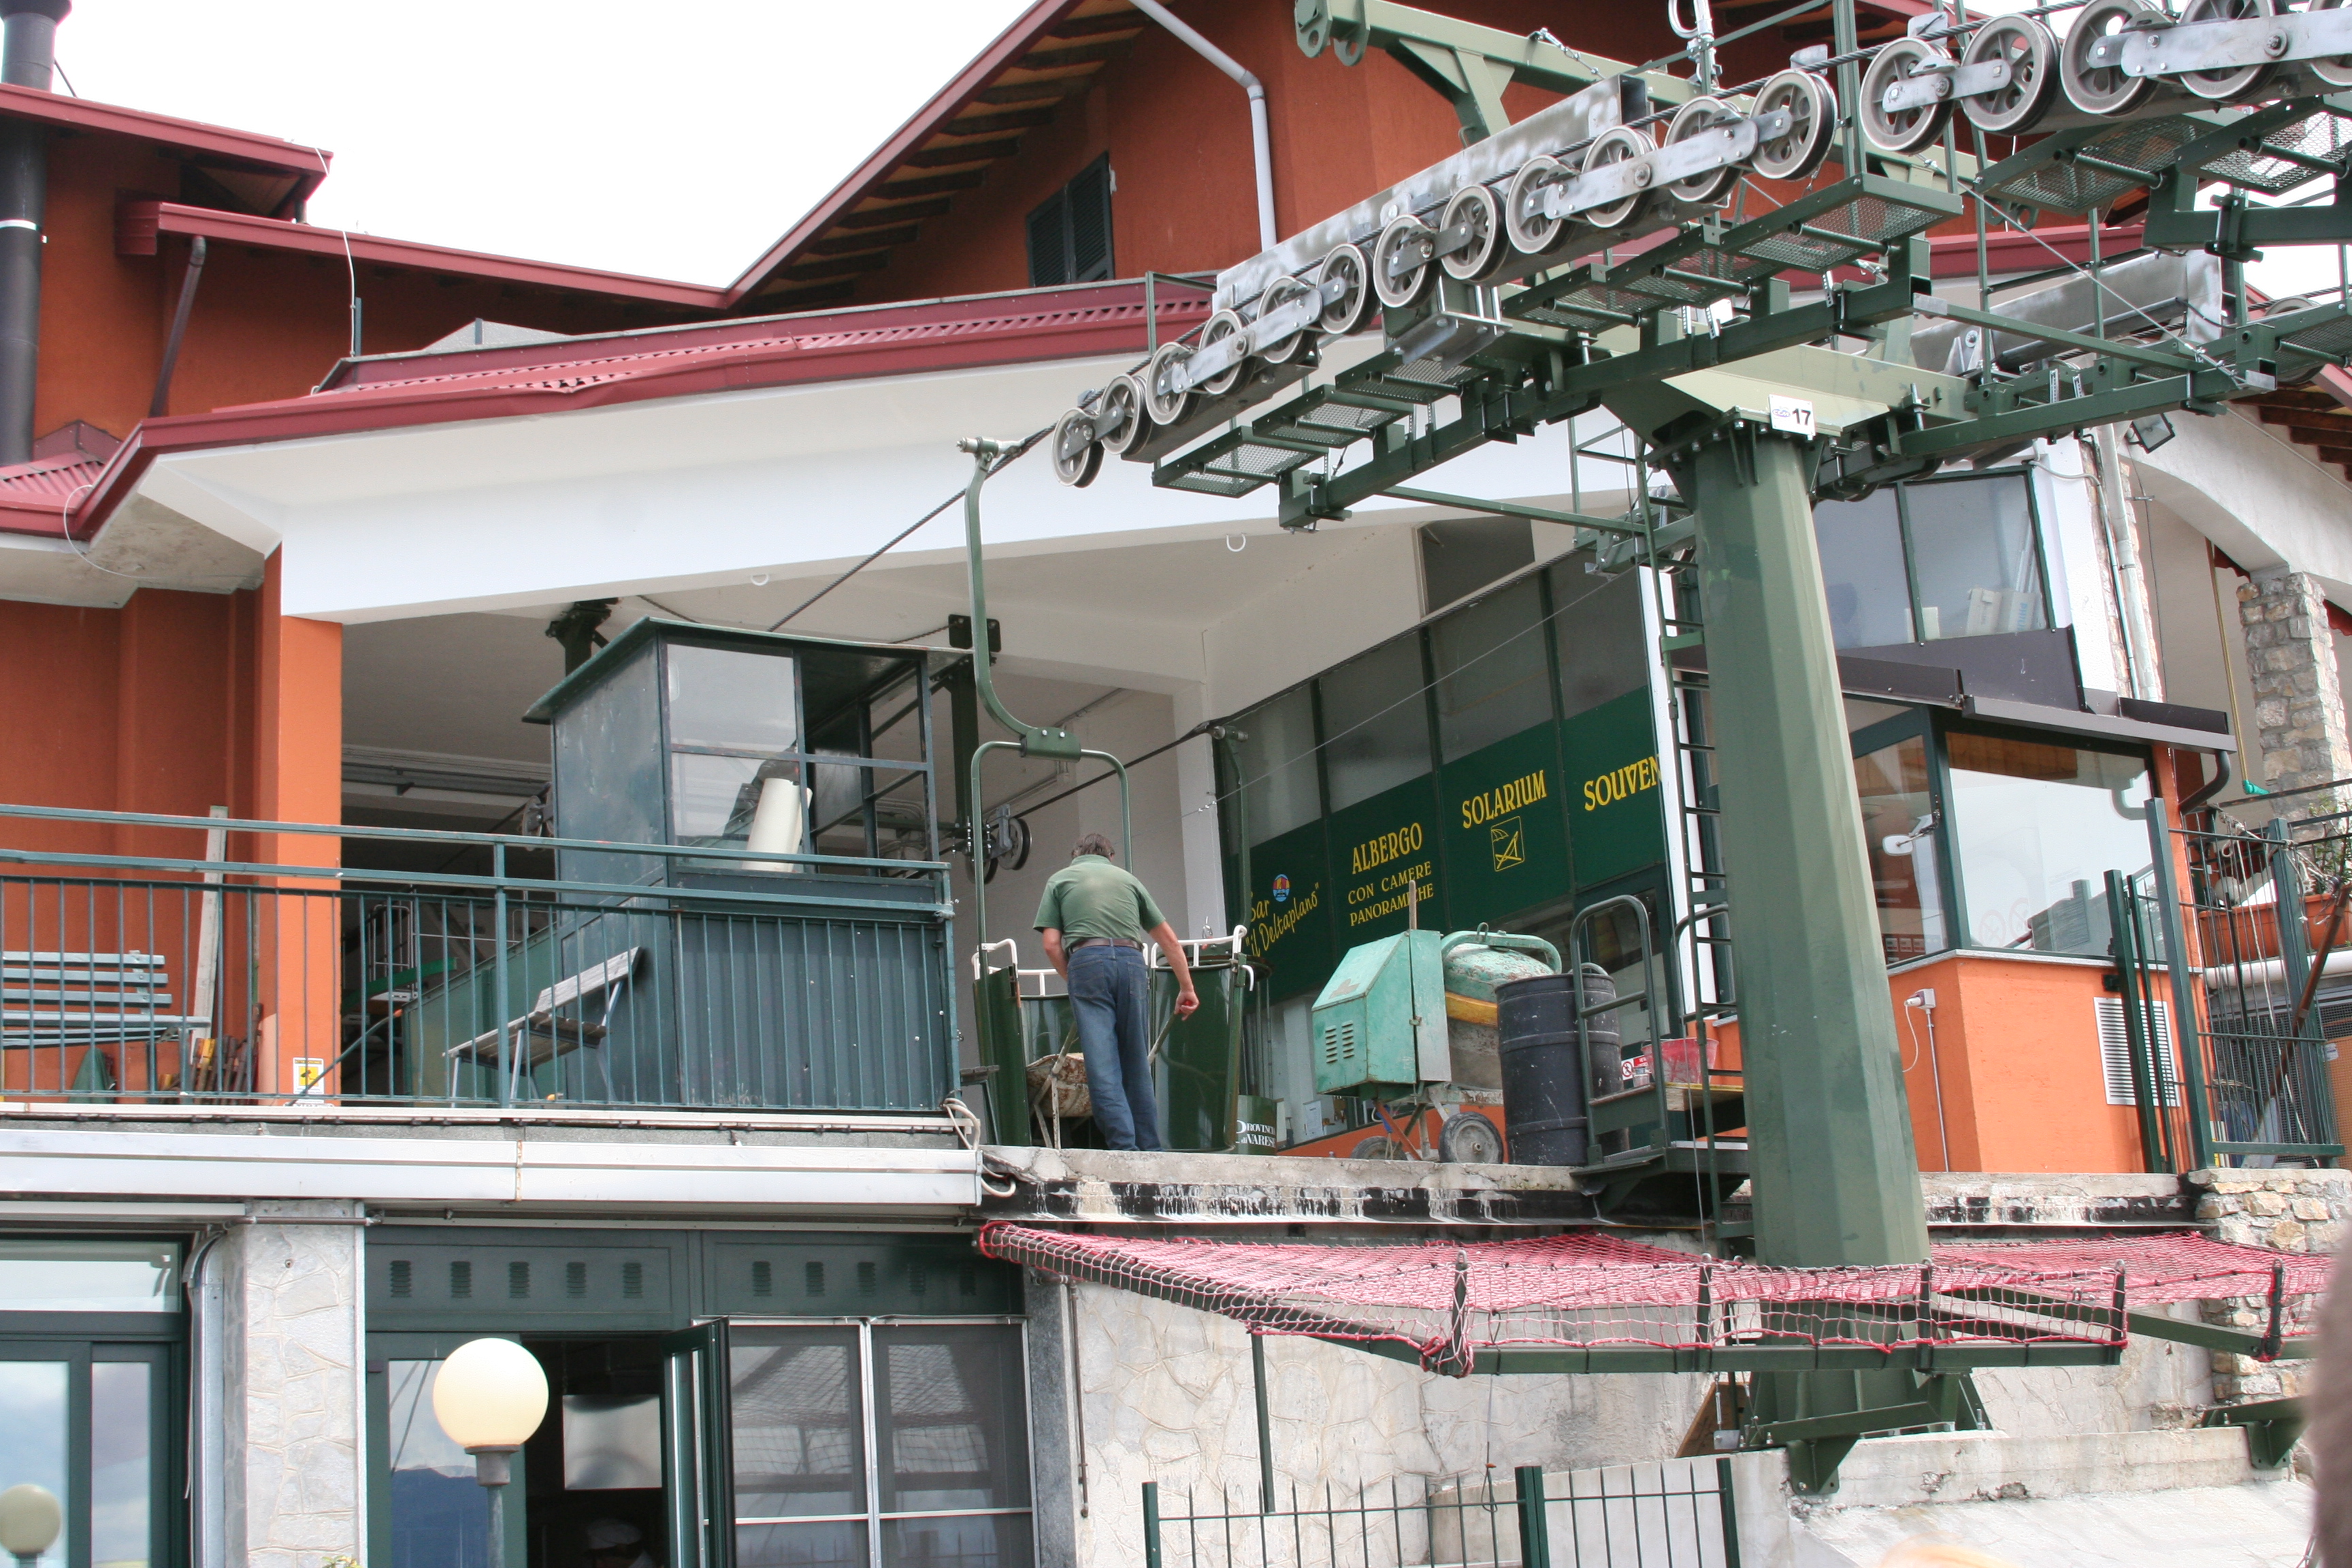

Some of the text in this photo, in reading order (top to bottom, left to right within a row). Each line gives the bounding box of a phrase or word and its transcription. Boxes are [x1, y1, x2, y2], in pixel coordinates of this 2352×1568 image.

[1792, 408, 1811, 425] 17
[1462, 770, 1547, 828] SOLARIUM
[1584, 755, 1661, 811] SOUVEN
[1352, 822, 1422, 875] ALBERGO
[1348, 861, 1431, 904] CON CAMERE
[1350, 883, 1434, 926] PANORAMIHE
[1259, 882, 1319, 951] Deltaplano"
